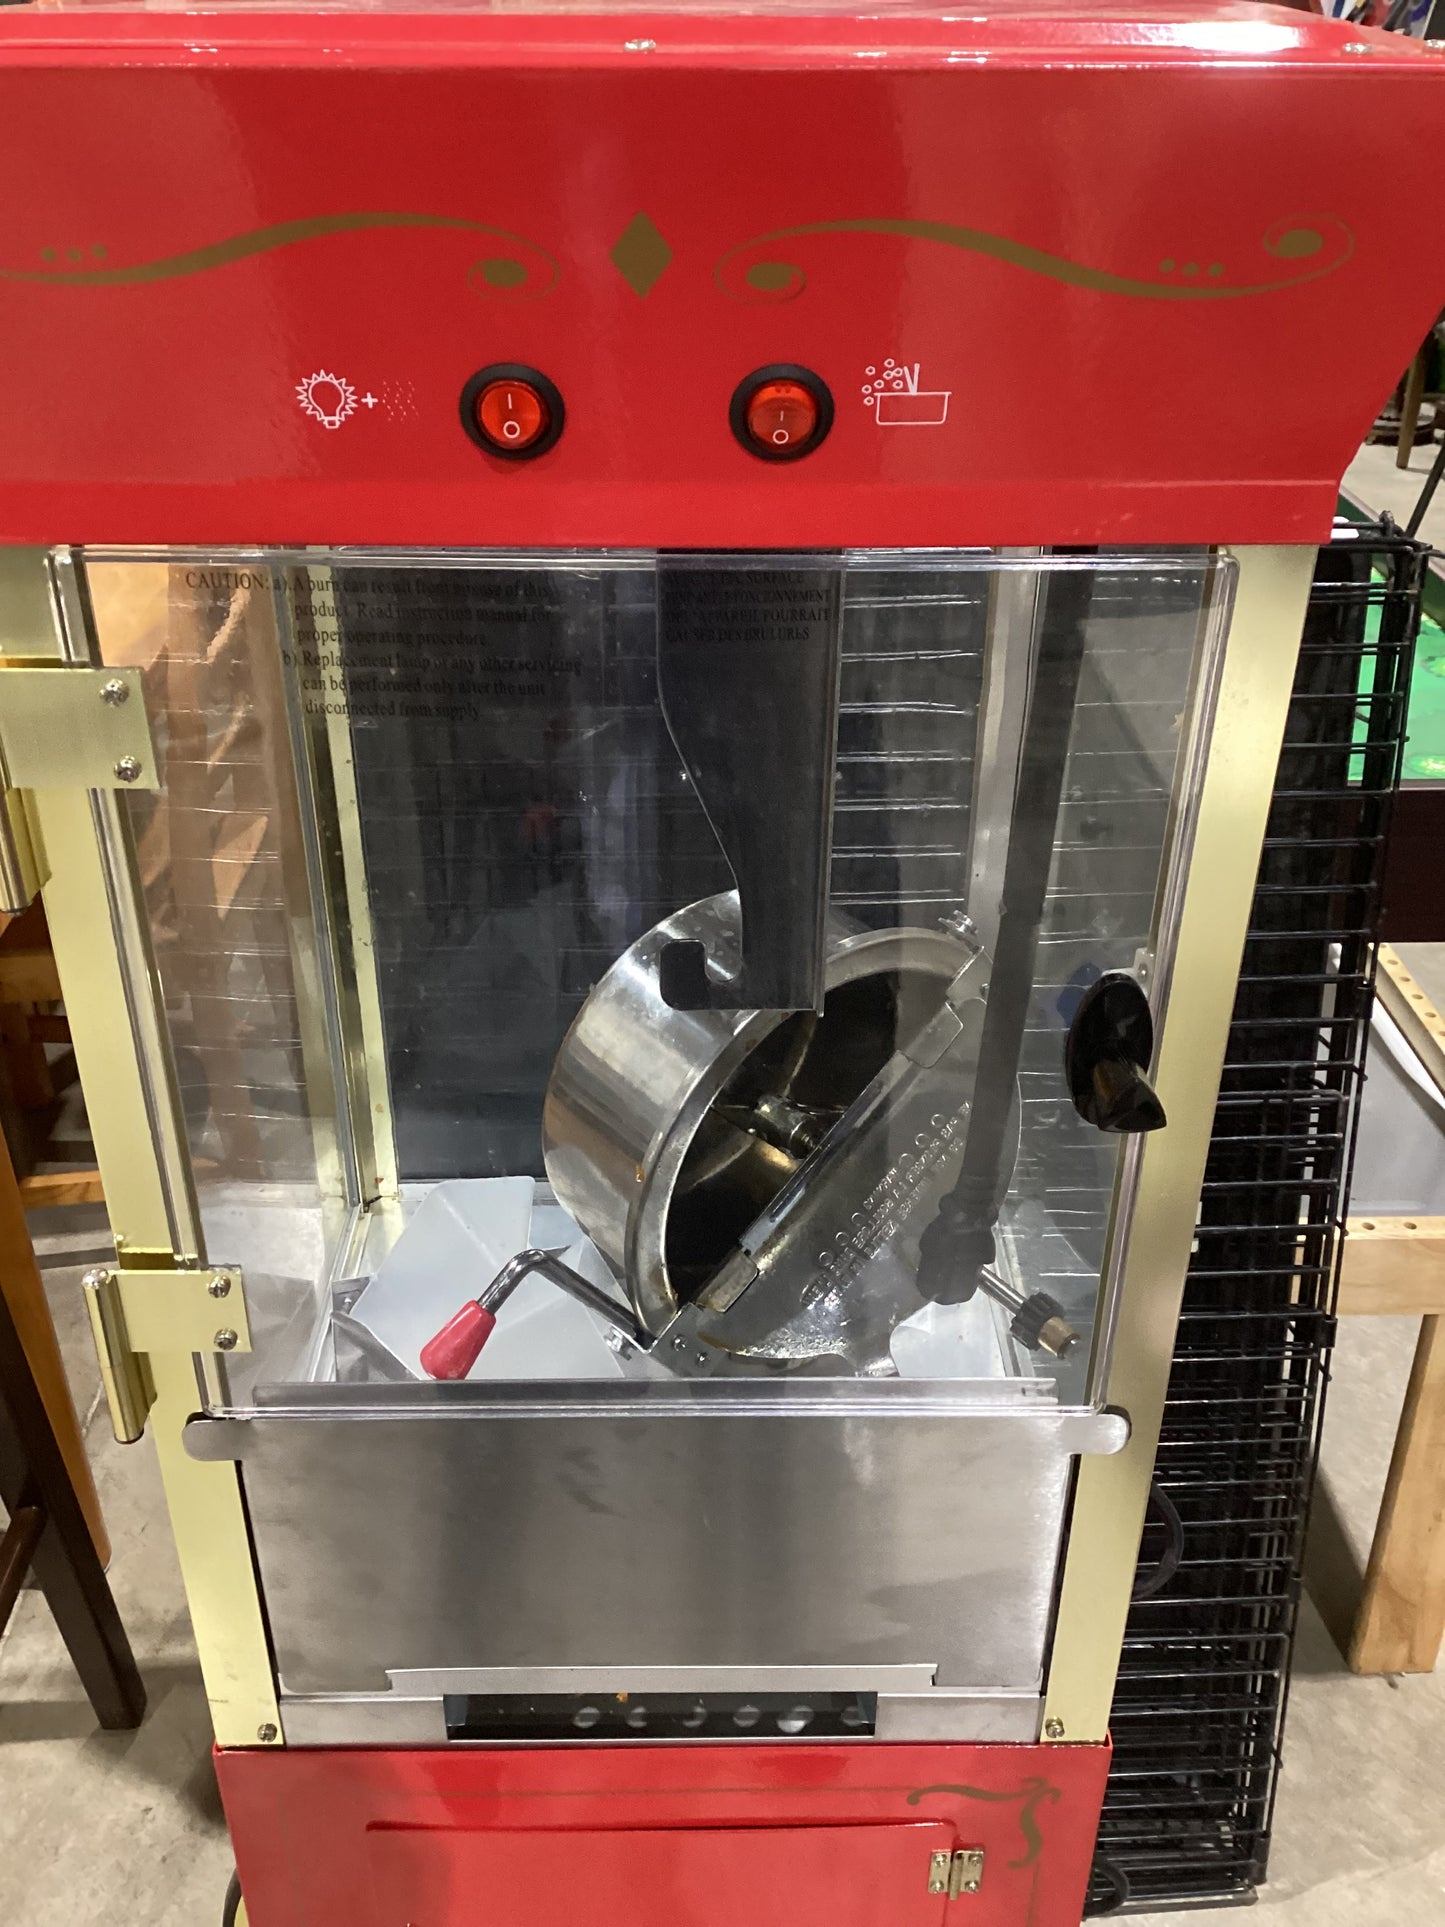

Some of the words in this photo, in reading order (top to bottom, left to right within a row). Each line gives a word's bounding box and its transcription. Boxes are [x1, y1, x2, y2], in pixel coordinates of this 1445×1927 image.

[185, 572, 270, 590] CAUTION:
[308, 578, 339, 592] burn
[357, 602, 393, 618] Read
[298, 629, 342, 646] proper
[345, 631, 414, 647] operating
[303, 677, 327, 690] can
[349, 677, 421, 695] performed
[494, 680, 516, 695] the
[305, 699, 396, 716] disconnected
[399, 700, 433, 717] from
